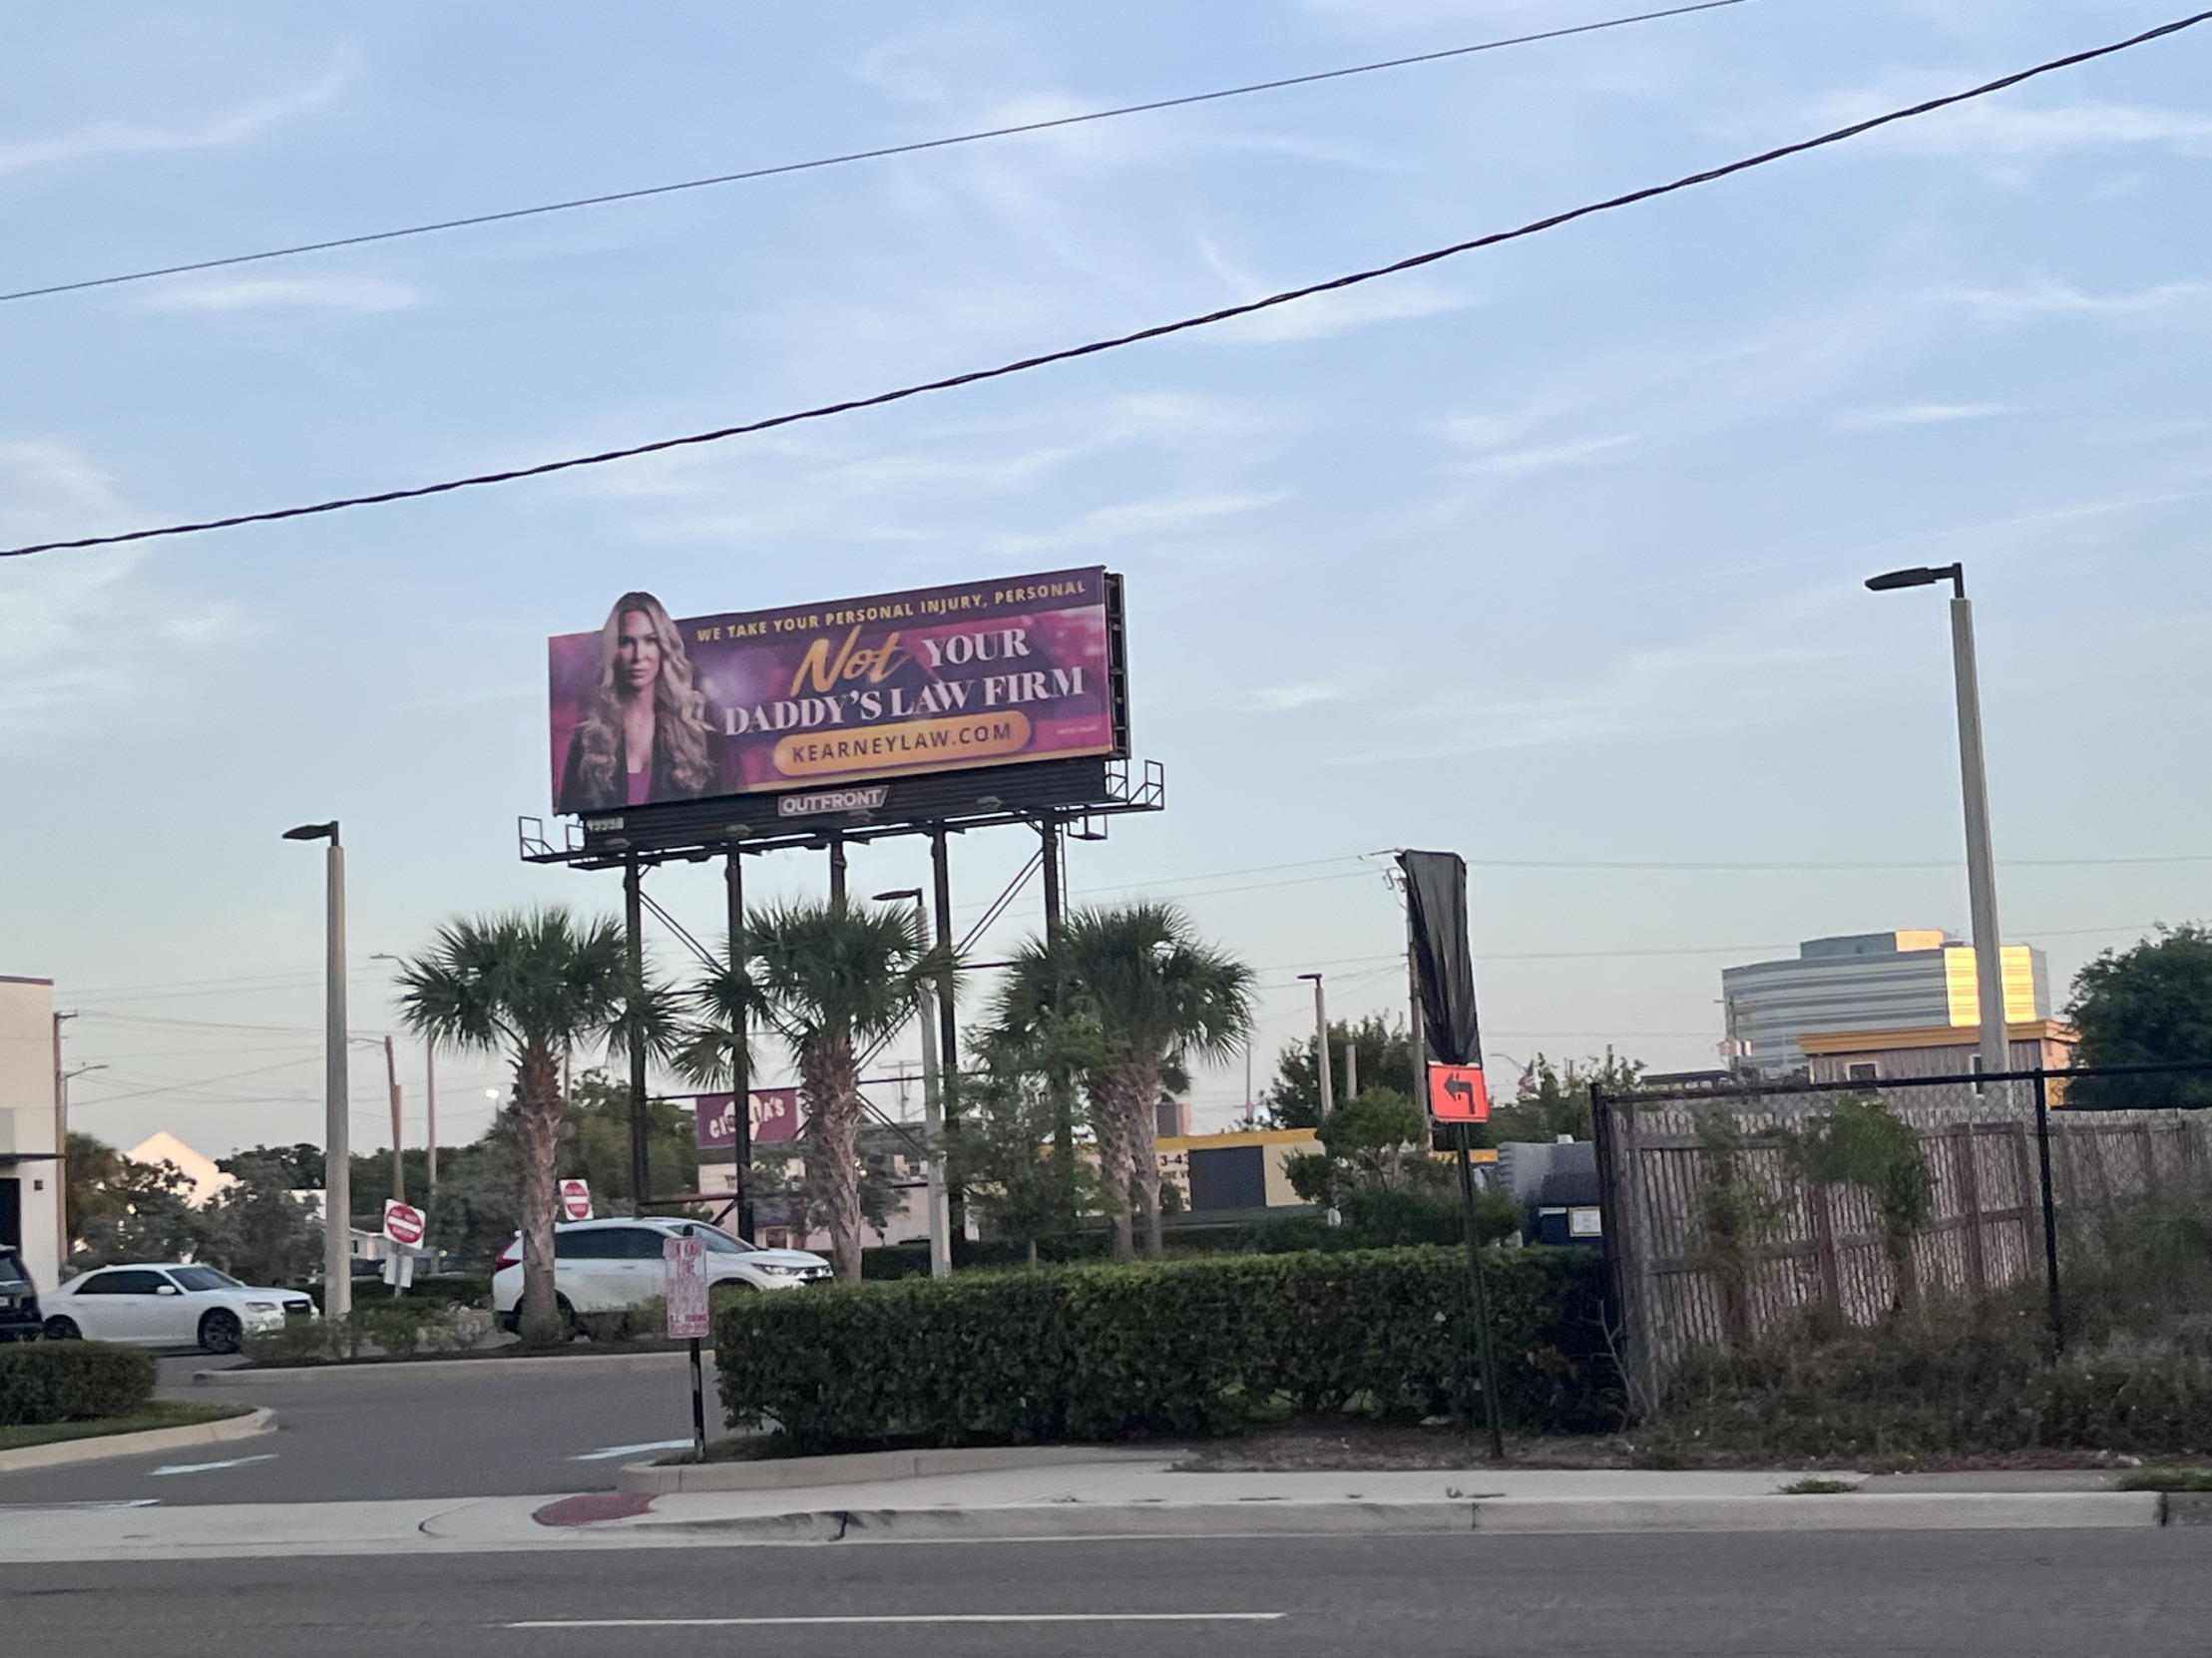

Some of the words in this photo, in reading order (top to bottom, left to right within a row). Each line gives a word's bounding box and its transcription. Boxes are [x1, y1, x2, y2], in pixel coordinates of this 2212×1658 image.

[696, 627, 720, 641] WE
[726, 622, 766, 638] TAKE
[773, 616, 819, 632] YOUR
[825, 604, 914, 626] PERSONAL
[921, 594, 987, 615] INJURY,
[995, 581, 1086, 604] PERSONAL
[790, 624, 913, 697] Not
[923, 628, 1031, 667] YOUR
[724, 689, 882, 735] DADDY'S
[890, 679, 976, 716] LAW
[984, 665, 1085, 706] FIRM
[792, 722, 1011, 763] KEARNEYLAW.COM
[782, 789, 882, 812] OUTFRONT
